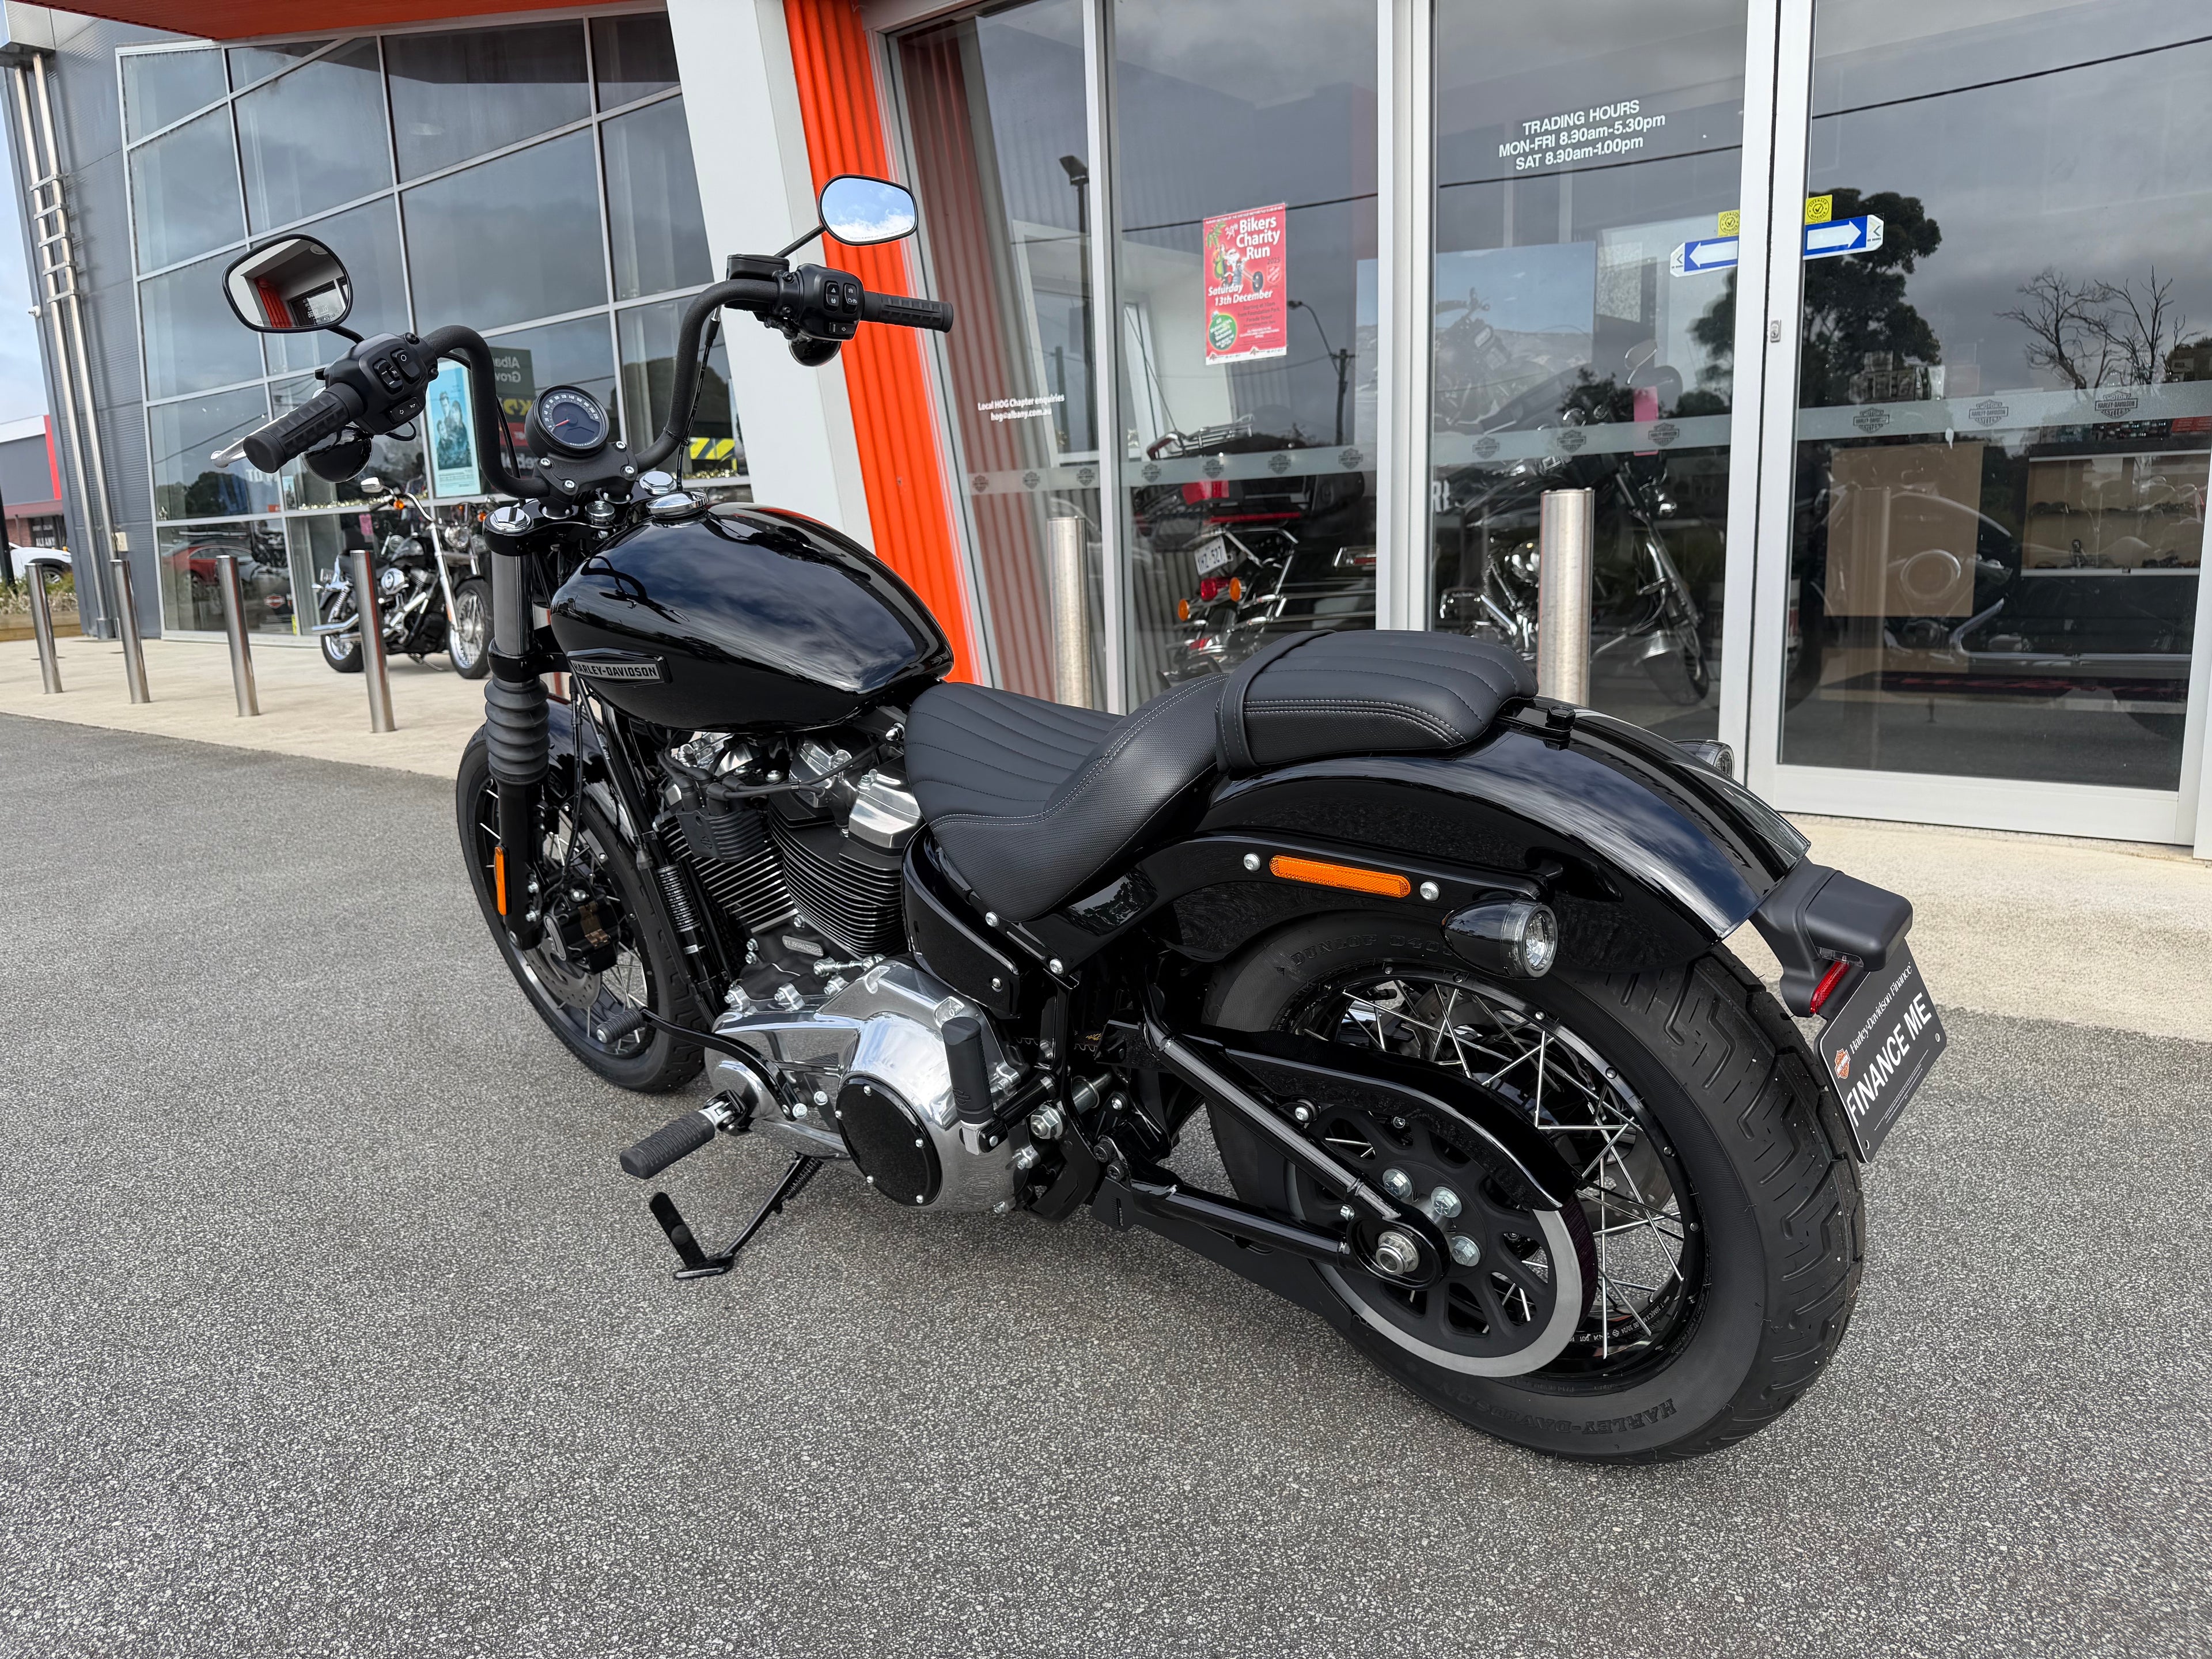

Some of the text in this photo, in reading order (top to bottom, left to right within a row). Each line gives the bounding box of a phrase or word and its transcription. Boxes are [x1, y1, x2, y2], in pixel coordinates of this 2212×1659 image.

[1522, 100, 1639, 135] TRADING HOURS
[1499, 115, 1665, 157] MON-FRI 8.30am-5.30pm
[1516, 137, 1643, 170] SAT 8.30am-1.00pm
[1240, 217, 1277, 233] Bikers
[1236, 229, 1281, 248] Charity
[1247, 246, 1270, 260] Run
[1208, 284, 1244, 296] Saturday
[1215, 289, 1273, 306] 13th December
[978, 400, 994, 411] Local
[994, 399, 1009, 409] HOG
[1009, 397, 1034, 408] Chapter
[573, 663, 657, 677] HARLEY-DAVIDSON
[1290, 934, 1377, 966] DUNLOP
[1849, 964, 1912, 1055] Harley-Davidson Finance
[1846, 1023, 1910, 1127] FINANCE
[1903, 992, 1933, 1041] ME
[1440, 1382, 1678, 1435] HARLEY-DAVIDSON
